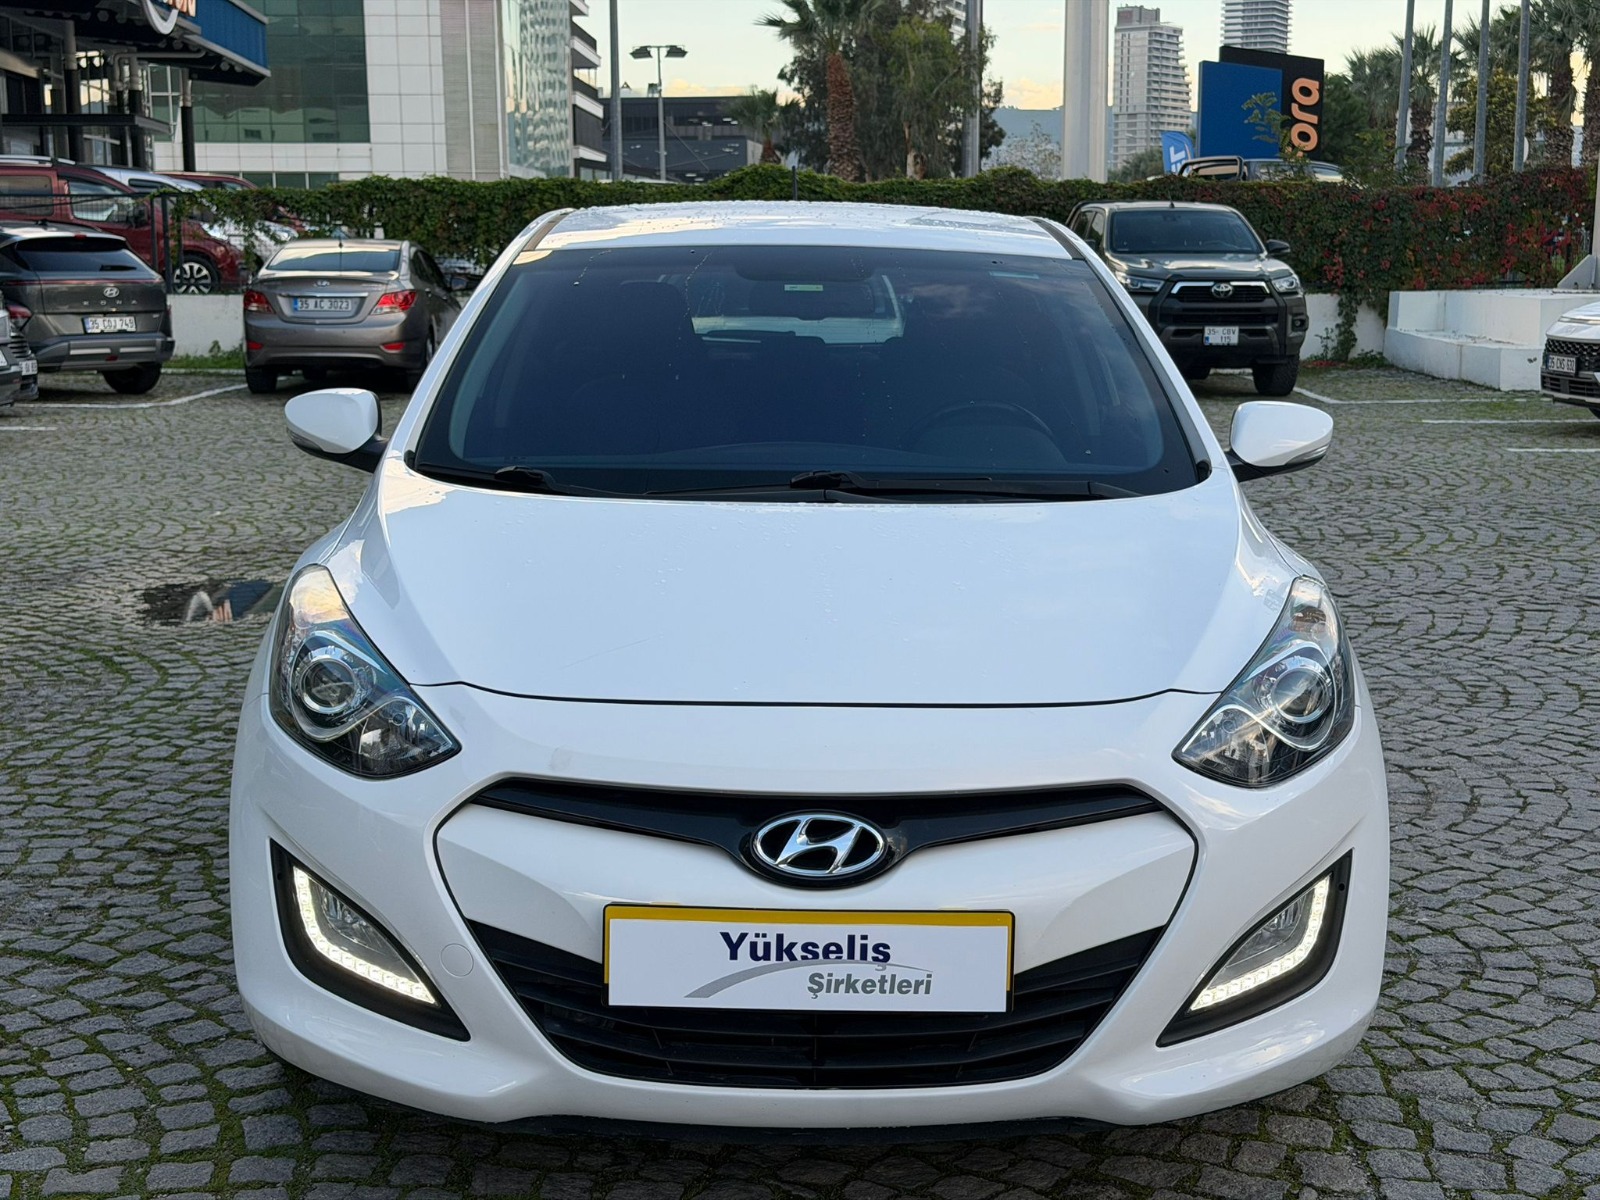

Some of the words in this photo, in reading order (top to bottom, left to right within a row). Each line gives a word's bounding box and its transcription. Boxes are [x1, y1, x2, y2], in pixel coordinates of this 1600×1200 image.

[1286, 77, 1320, 158] ora
[299, 300, 309, 310] 35
[313, 300, 325, 310] AC
[328, 300, 350, 310] 3023
[90, 319, 99, 329] 35
[719, 931, 892, 972] Yükseliş
[807, 971, 933, 1000] Şirketleri
